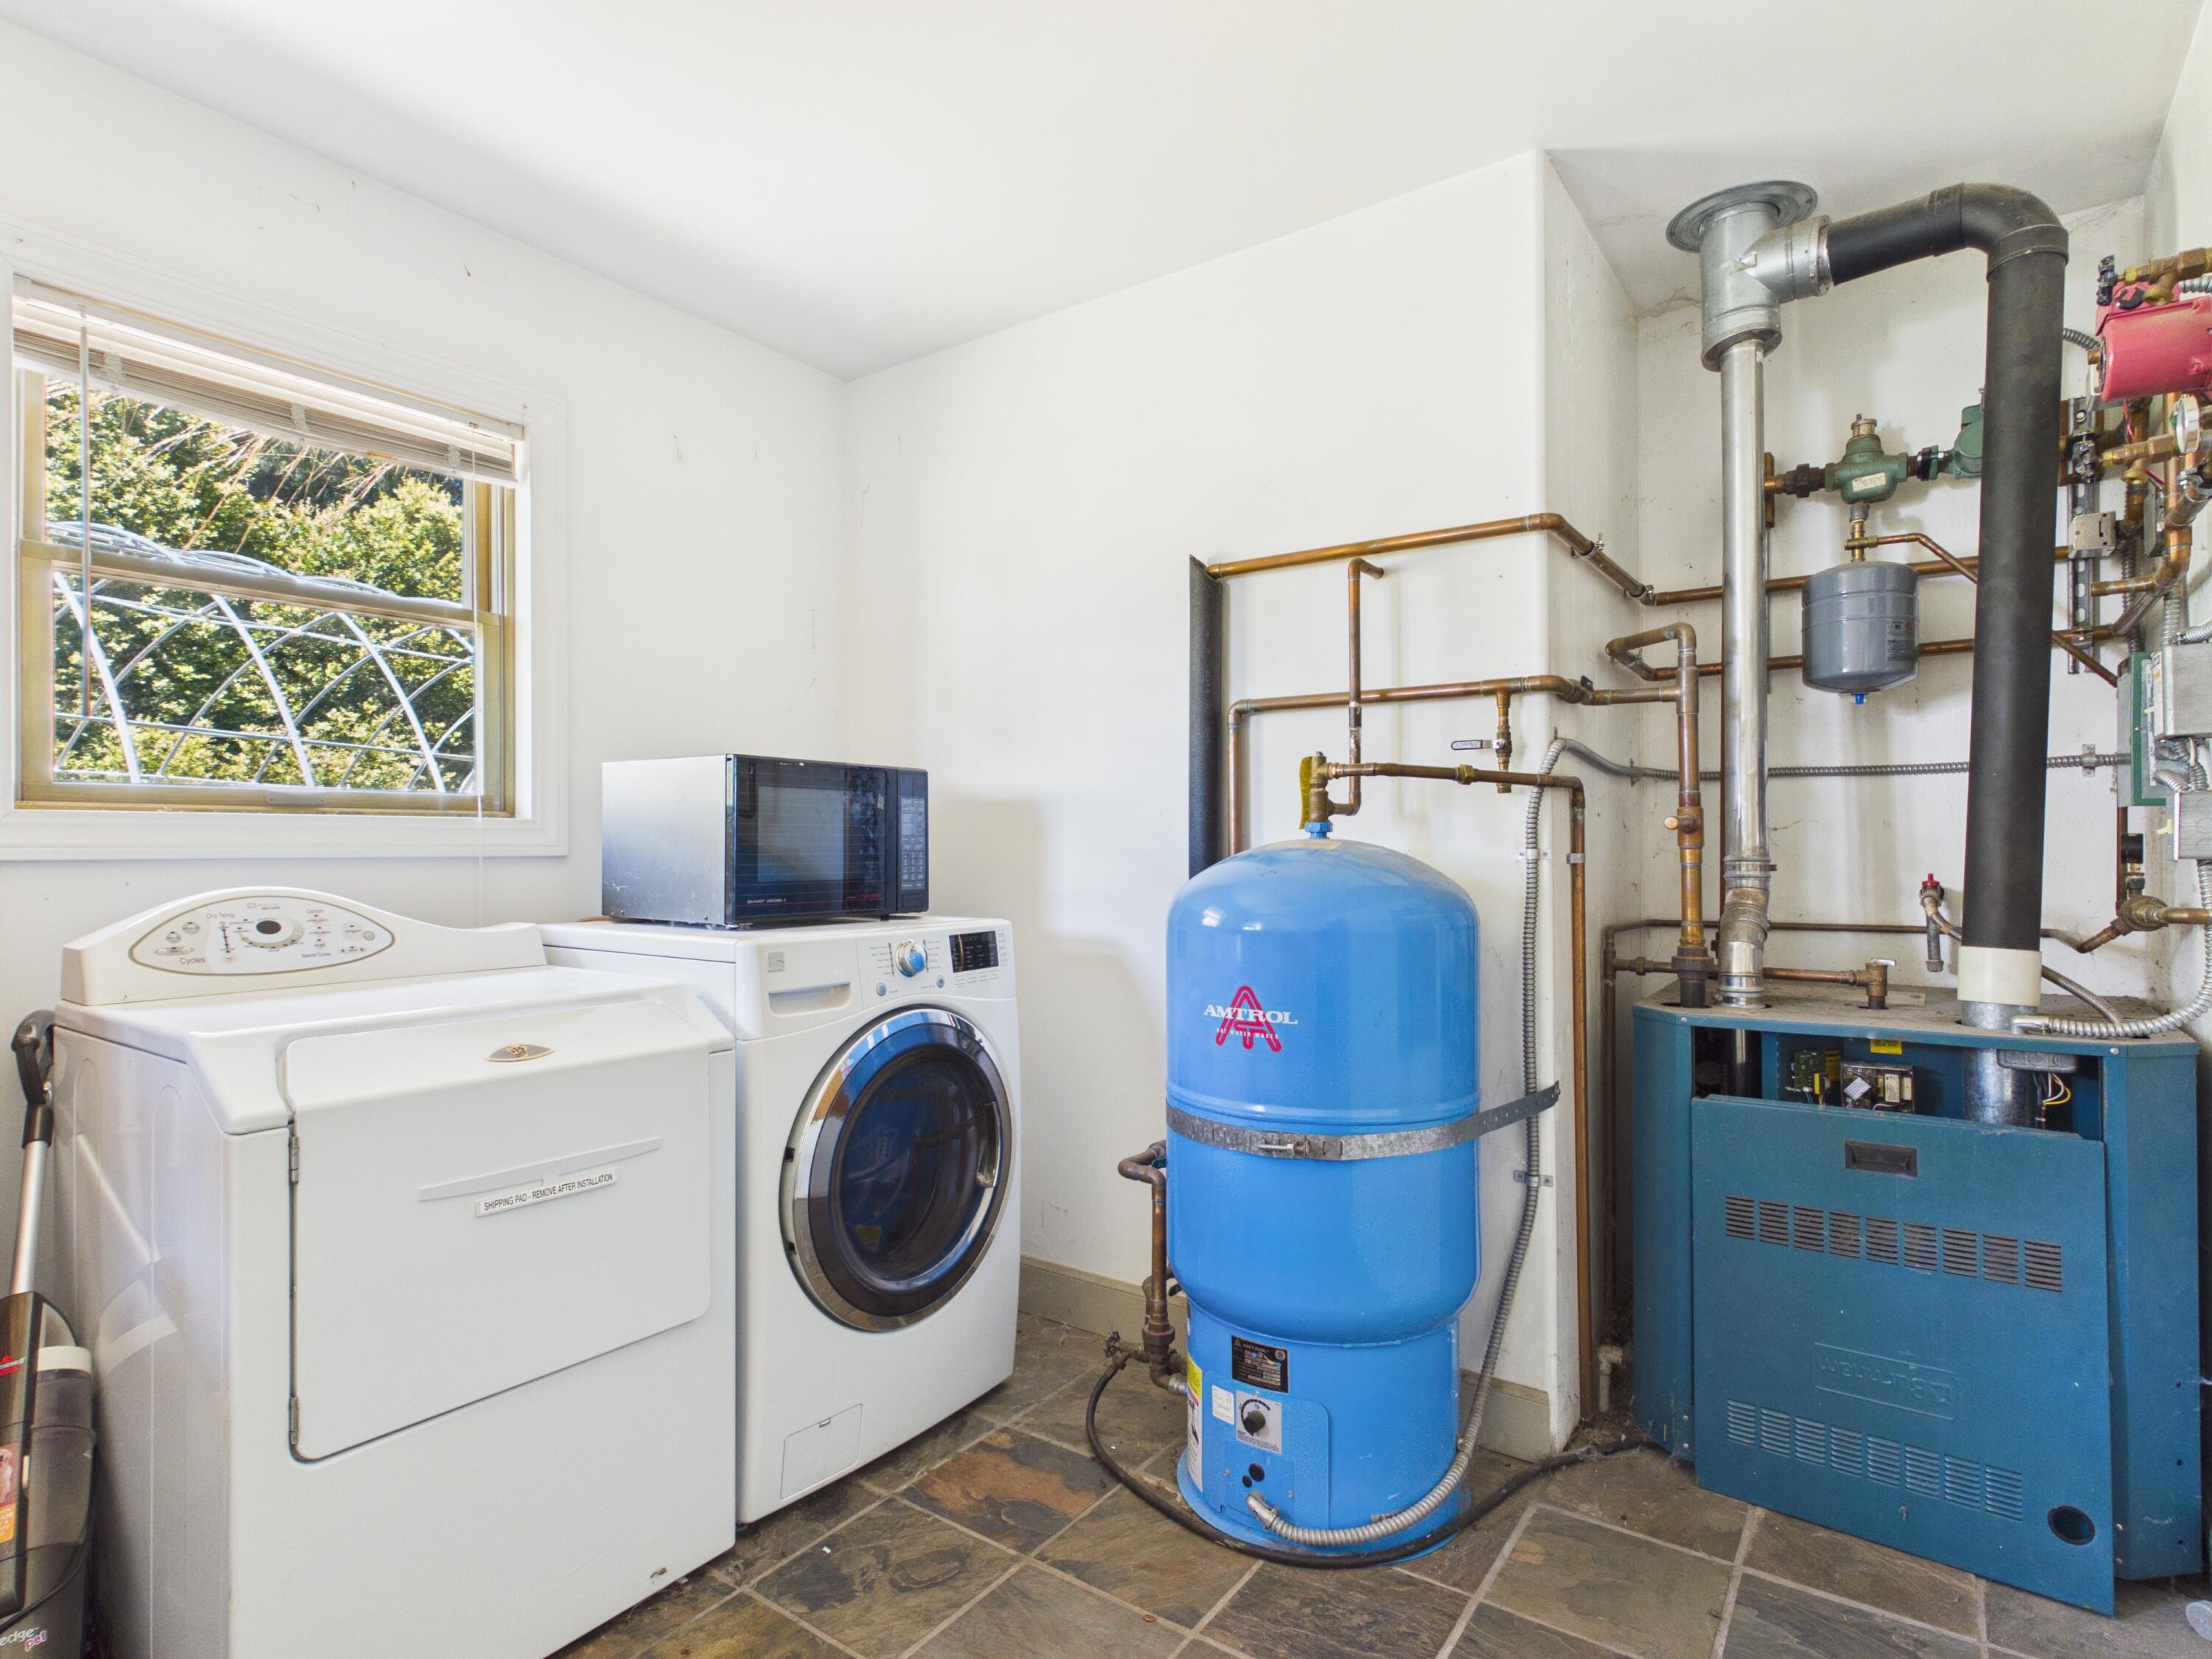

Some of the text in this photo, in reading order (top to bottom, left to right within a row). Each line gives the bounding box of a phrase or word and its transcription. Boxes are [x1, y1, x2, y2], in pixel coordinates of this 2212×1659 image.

[179, 957, 206, 966] Cycles
[1203, 1004, 1298, 1024] AMTROL
[484, 1196, 514, 1211] SHIPPING
[515, 1193, 527, 1203] PAD
[532, 1186, 556, 1200] REMOVE
[557, 1181, 577, 1193] AFTER
[577, 1173, 613, 1189] INSTALLATION
[24, 1630, 47, 1652] pet
